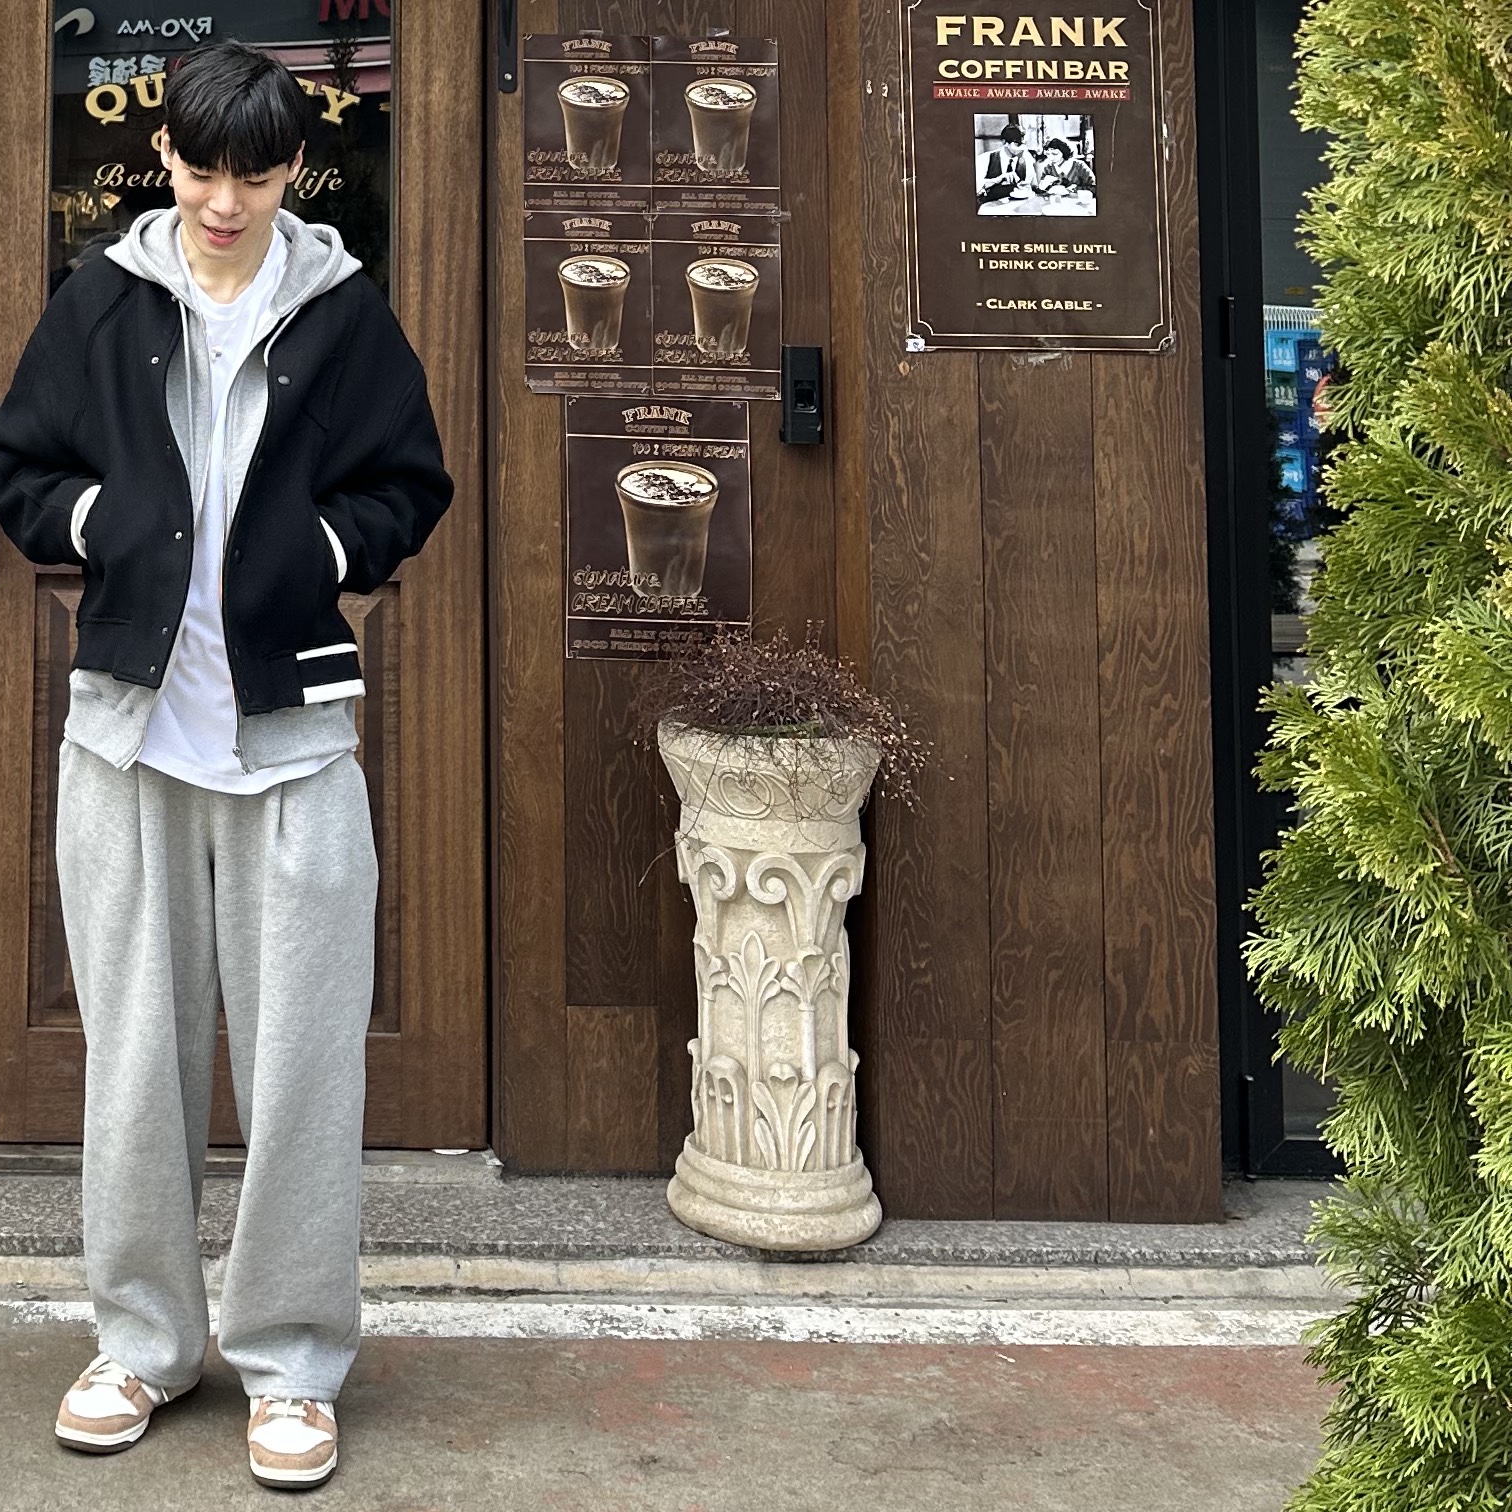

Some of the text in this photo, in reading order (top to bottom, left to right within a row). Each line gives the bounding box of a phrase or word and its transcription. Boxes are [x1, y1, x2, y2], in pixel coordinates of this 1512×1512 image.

[936, 15, 1129, 47] FRANK
[938, 59, 1130, 81] COFFIN BAR
[937, 88, 1127, 100] AWAKE AWAKE AWAKE AWAKE
[93, 162, 346, 200] Bett life
[960, 241, 1117, 255] I NEVER SMILE UNTIL
[978, 258, 1100, 272] I DRINK COFFEE.
[621, 405, 693, 426] FRANK
